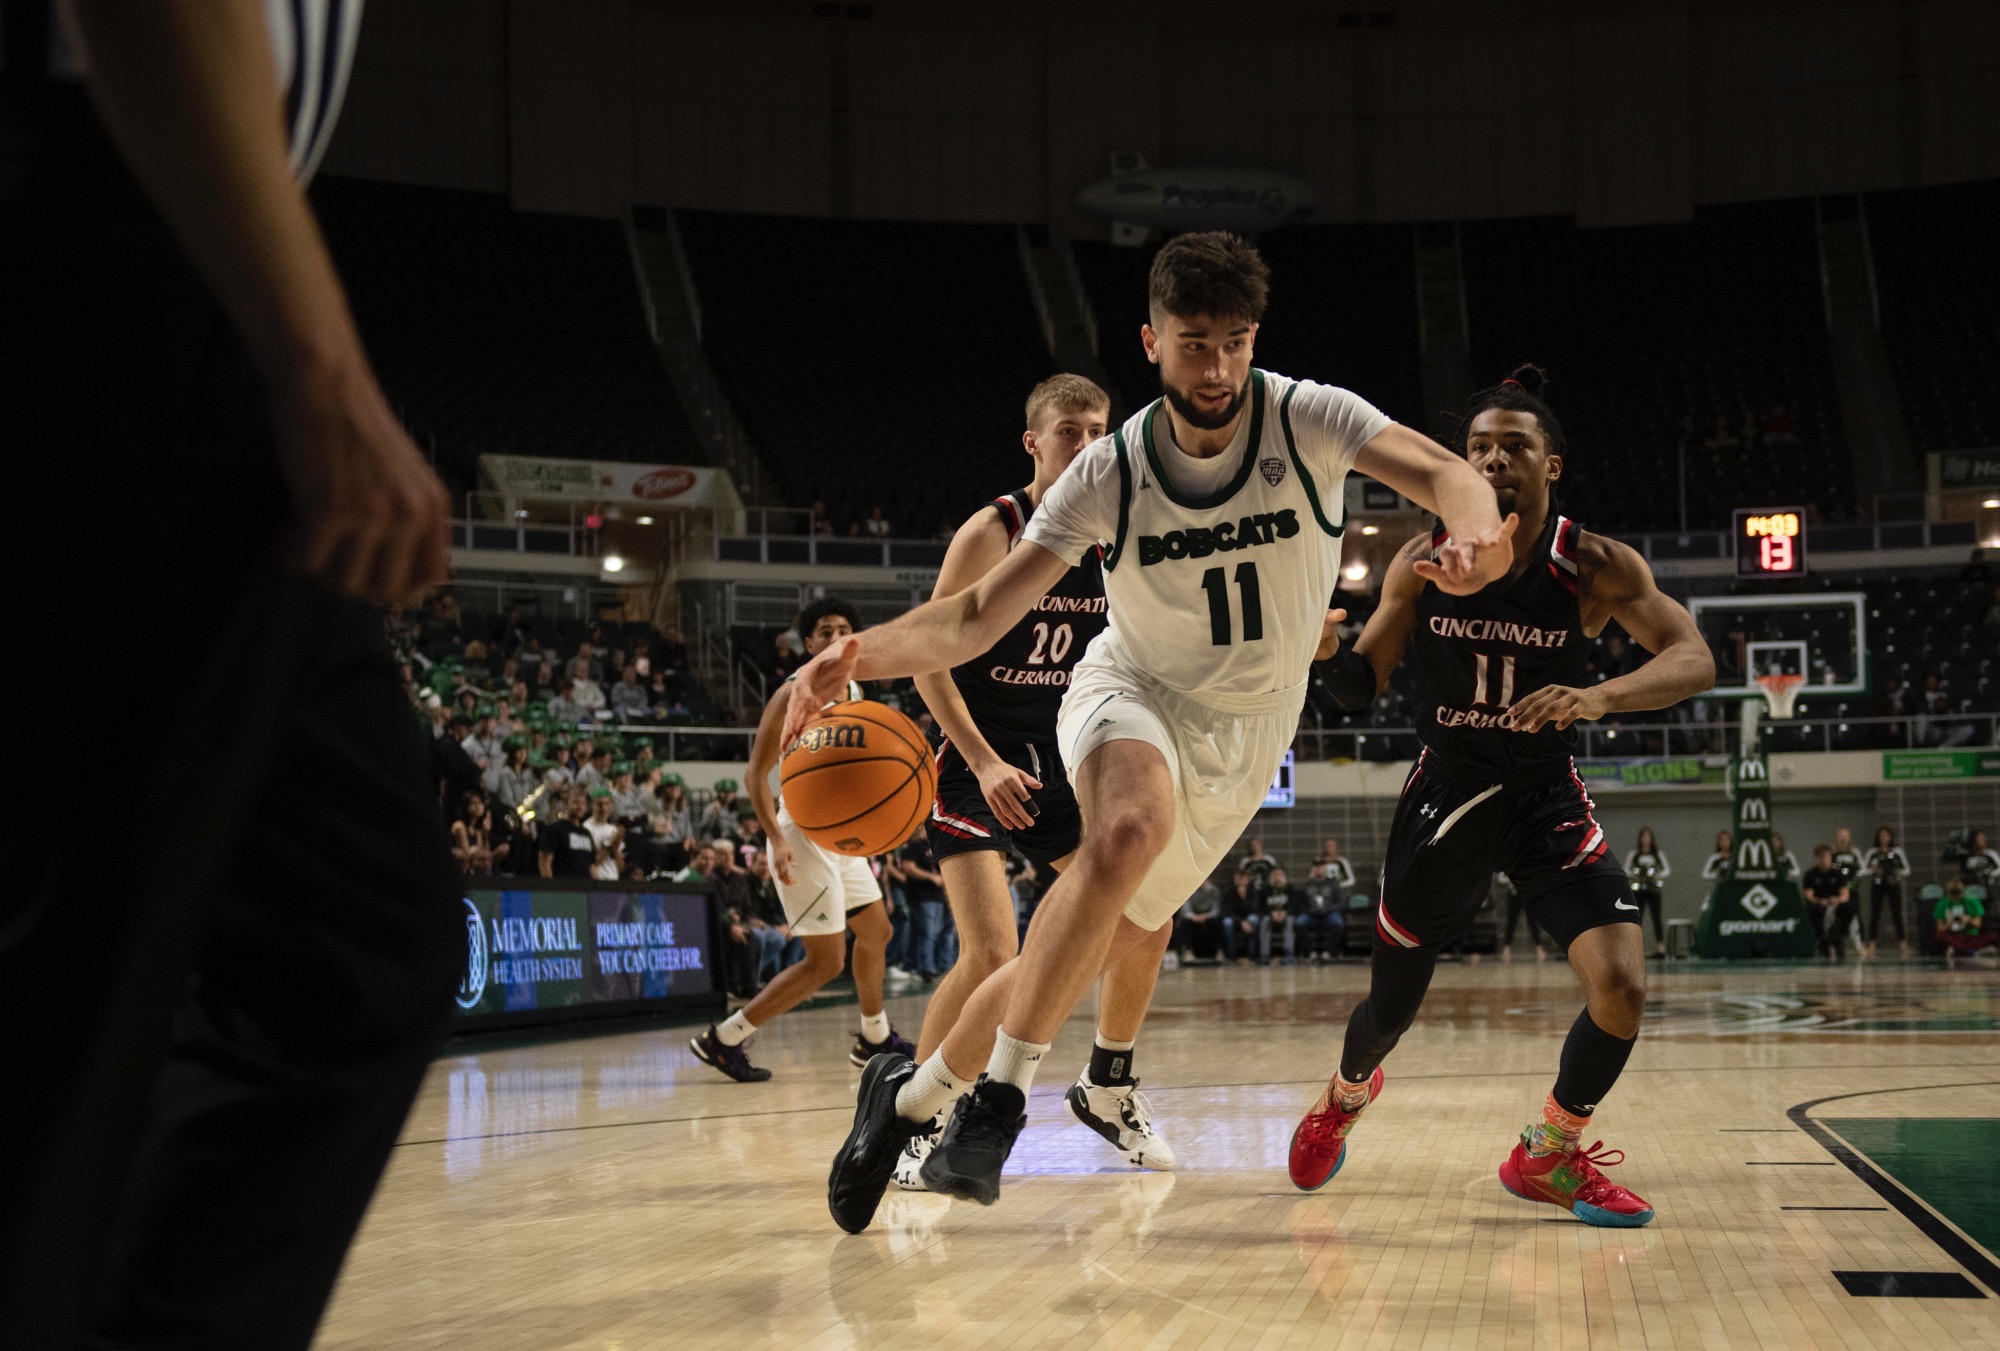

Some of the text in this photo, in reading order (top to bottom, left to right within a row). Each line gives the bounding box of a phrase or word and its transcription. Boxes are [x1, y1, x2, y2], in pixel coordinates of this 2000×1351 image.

[1138, 508, 1300, 567] BOBCATS
[1760, 535, 1794, 571] 13
[1201, 561, 1264, 646] 11
[1025, 621, 1074, 665] 20
[1428, 615, 1569, 648] CINCINNATI
[1471, 651, 1517, 709] 11
[1436, 704, 1519, 730] CLERMO
[1621, 757, 1700, 785] SIGNS
[491, 916, 582, 953] MEMORIAL
[596, 921, 675, 948] PRIMARY CARE
[1719, 918, 1798, 937] gomart
[493, 957, 583, 985] HEALTH SYSTEM
[598, 949, 623, 976] YOU
[623, 948, 647, 974] CAN
[647, 947, 681, 972] CHEER
